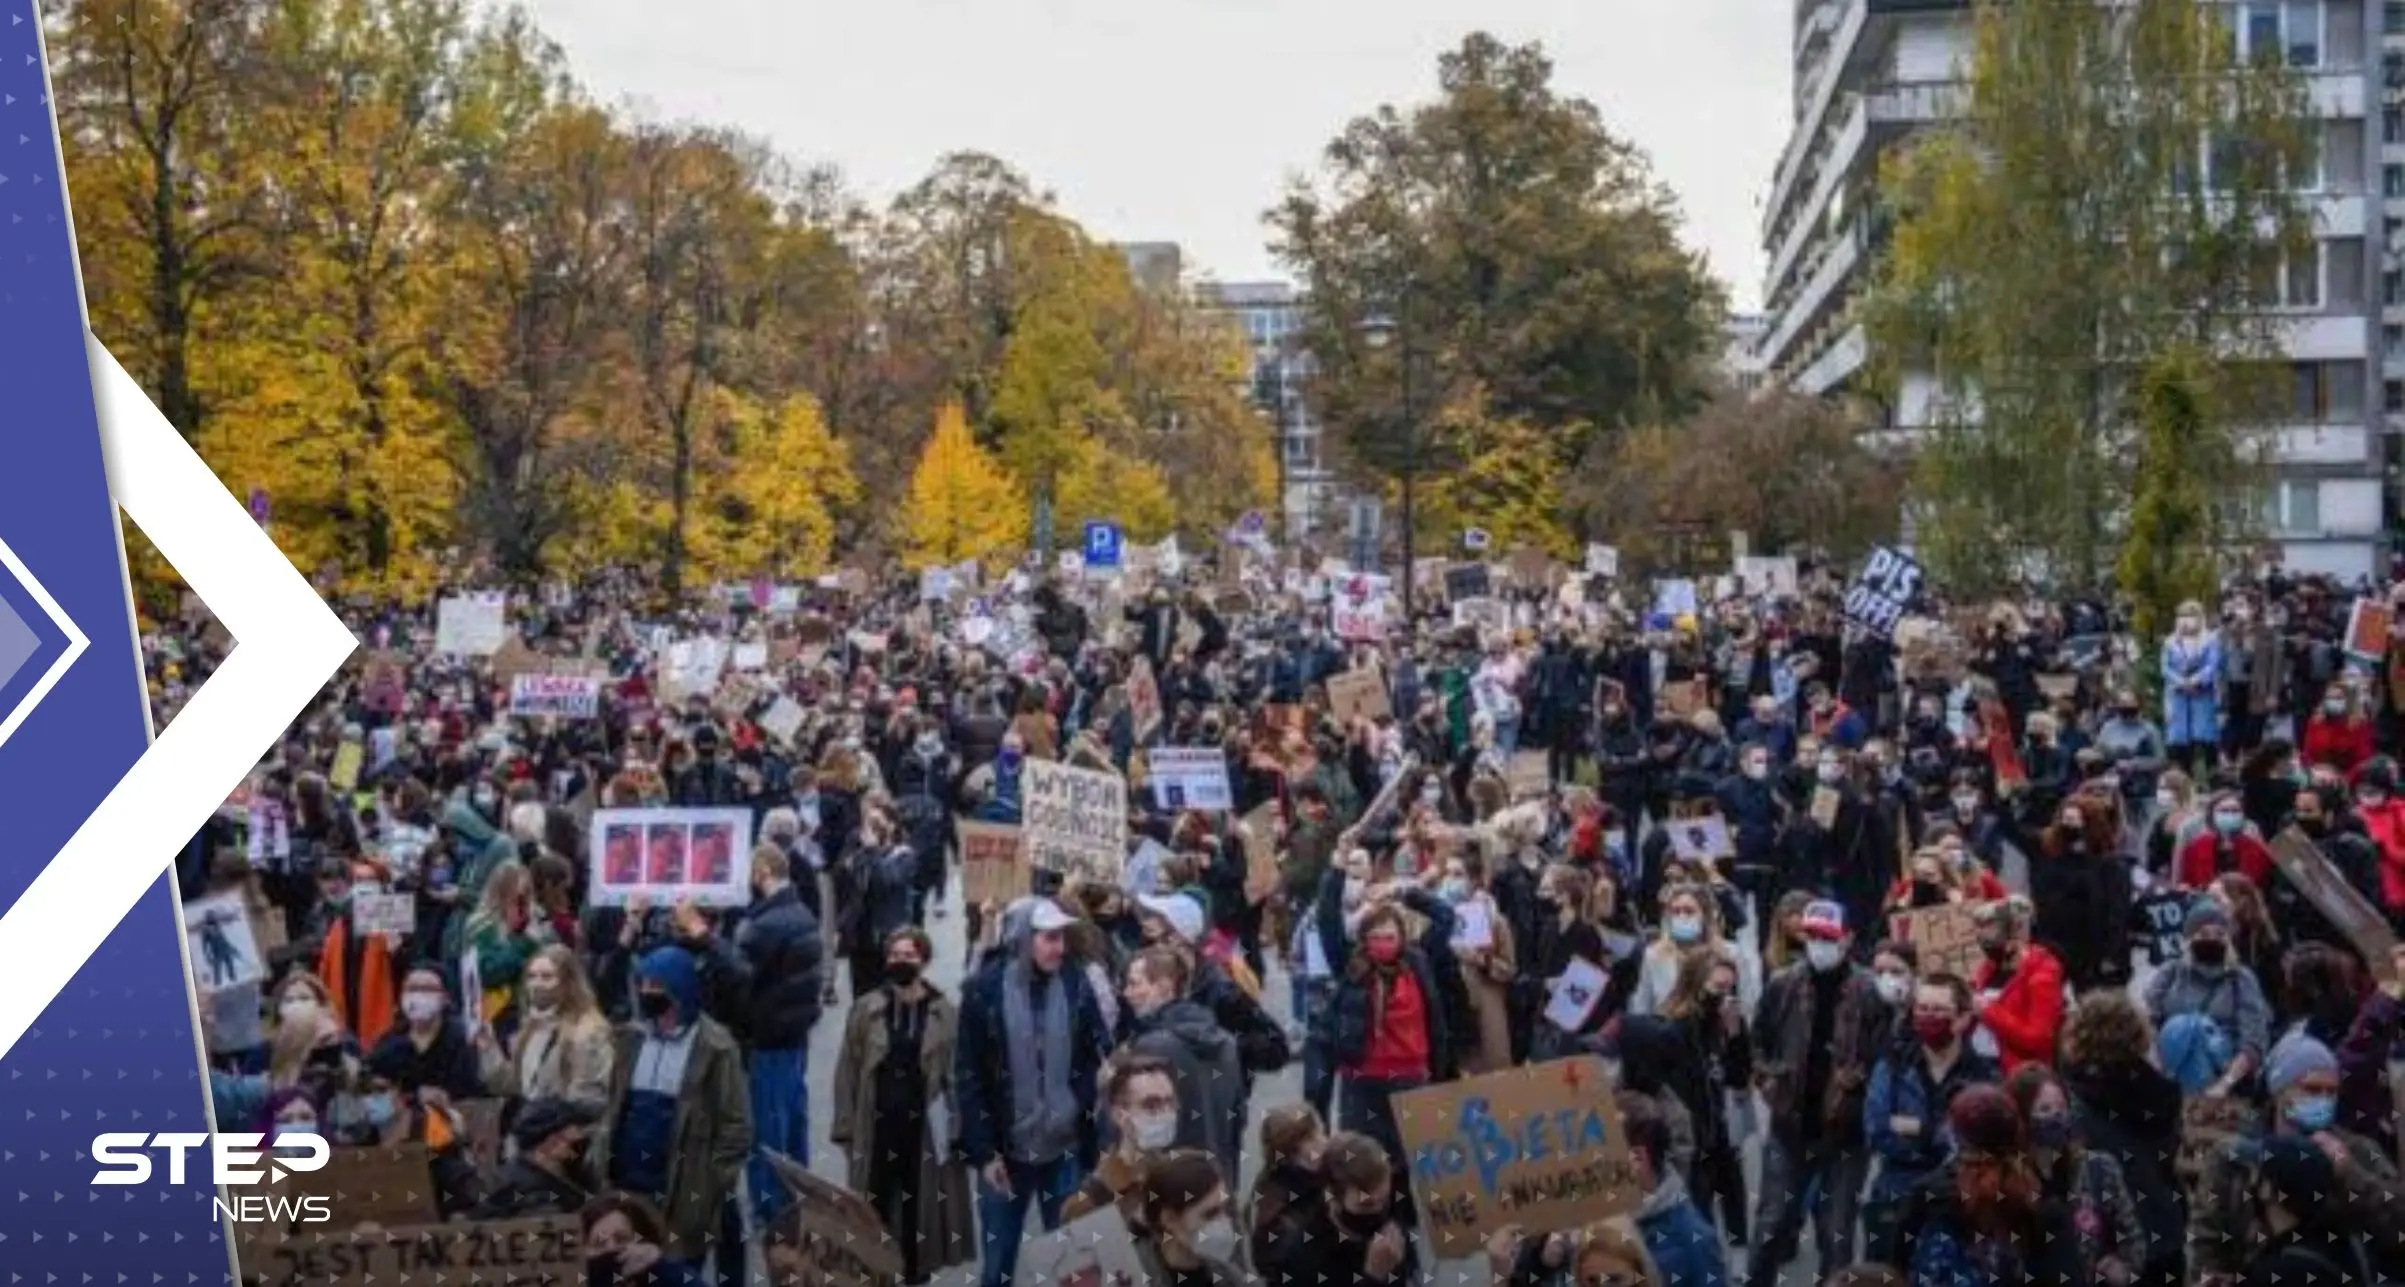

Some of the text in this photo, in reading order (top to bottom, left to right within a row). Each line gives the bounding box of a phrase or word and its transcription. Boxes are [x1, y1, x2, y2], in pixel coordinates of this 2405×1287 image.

[1092, 526, 1113, 554] P
[1863, 547, 1920, 602] PIS
[2146, 901, 2181, 929] TO
[387, 1235, 456, 1270] TAK
